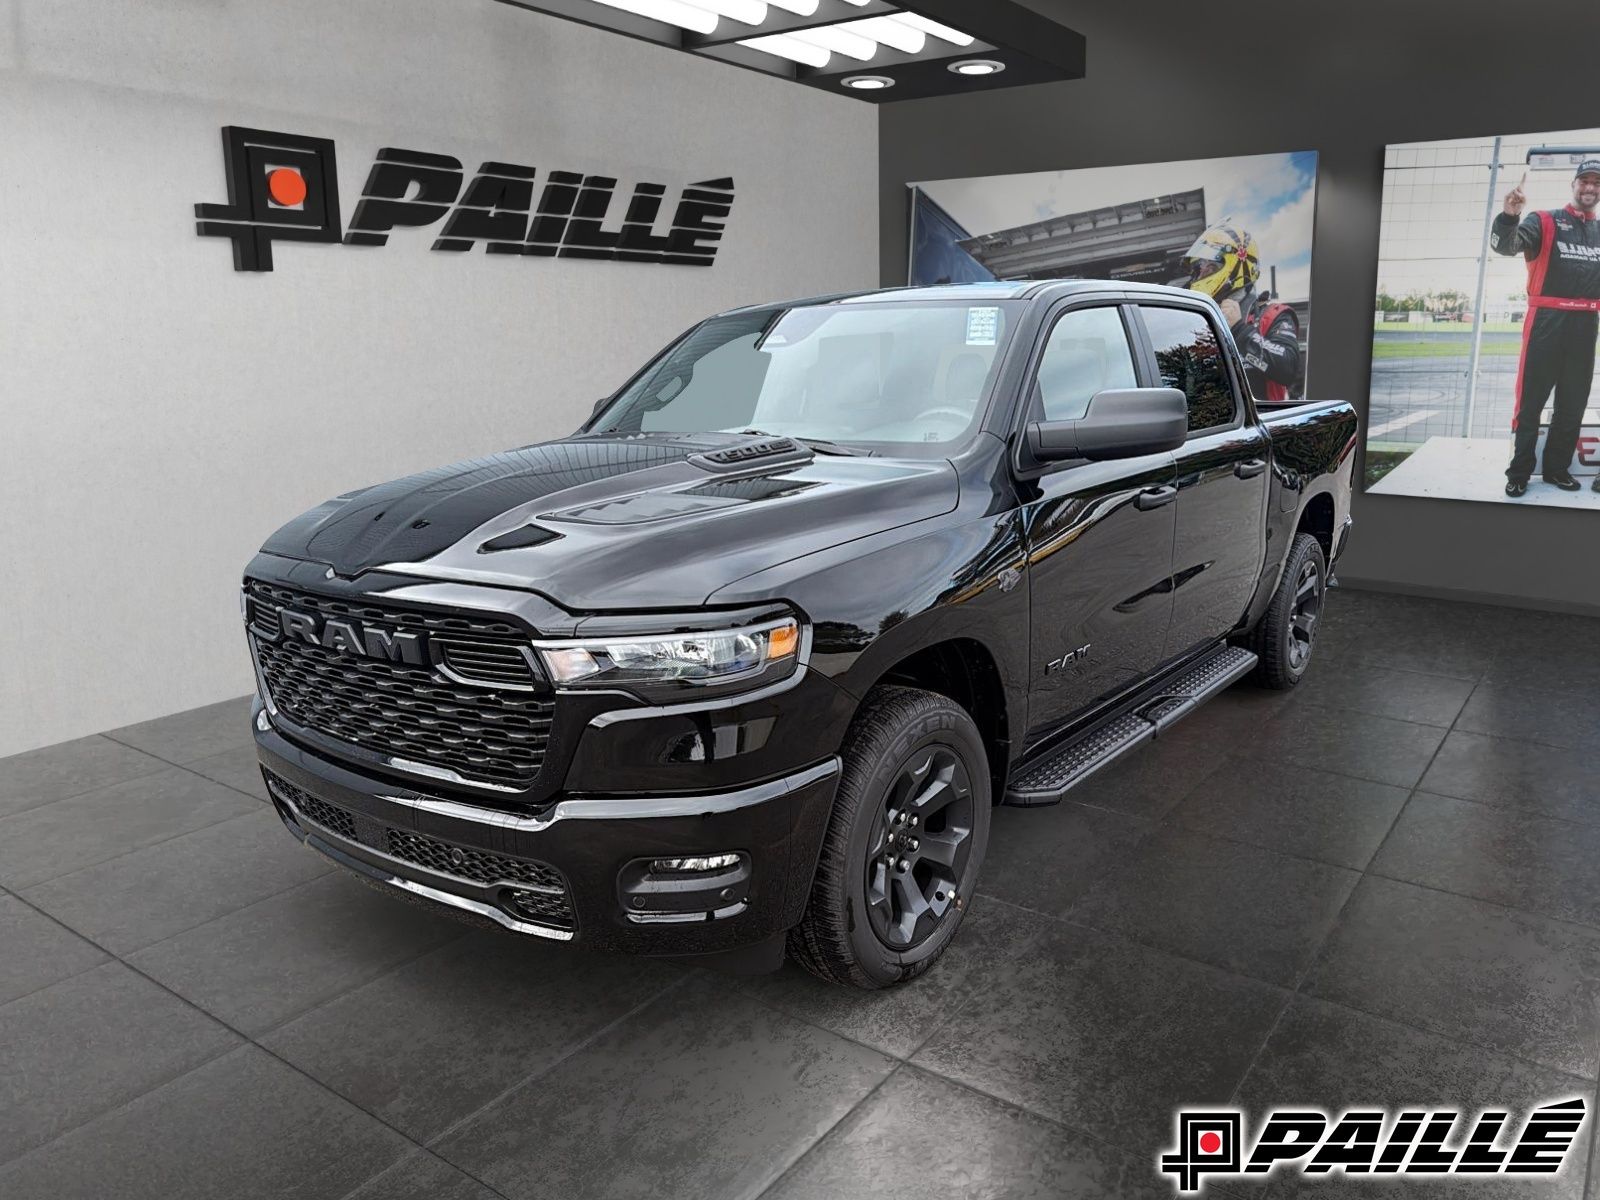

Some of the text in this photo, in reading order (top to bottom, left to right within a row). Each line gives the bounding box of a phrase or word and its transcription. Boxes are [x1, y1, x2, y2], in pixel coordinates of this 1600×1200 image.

[343, 147, 734, 266] PAILLÉ
[281, 607, 426, 665] RAM
[878, 714, 956, 782] NEXEN
